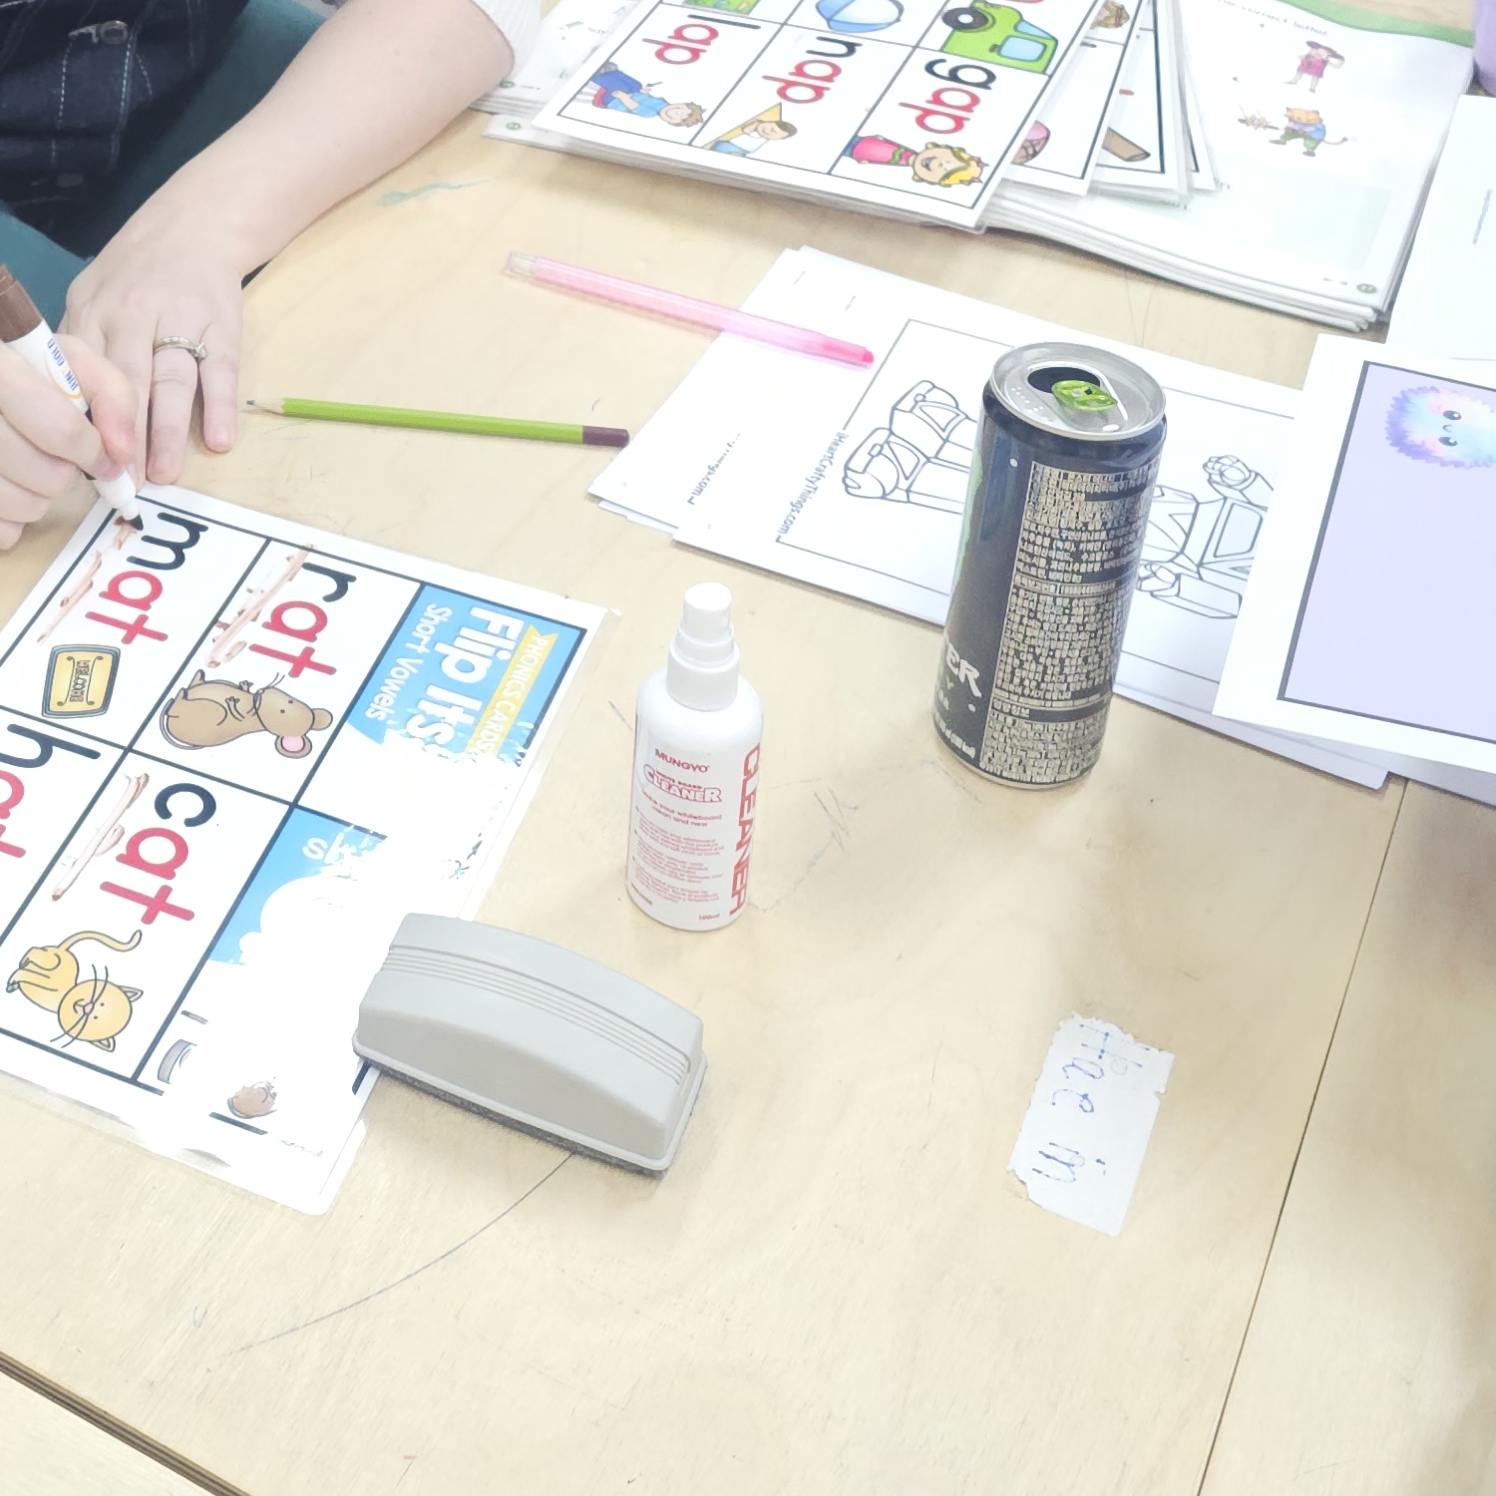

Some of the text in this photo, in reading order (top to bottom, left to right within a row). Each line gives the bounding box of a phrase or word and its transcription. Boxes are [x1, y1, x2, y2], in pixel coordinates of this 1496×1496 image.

[641, 13, 762, 66] lap
[761, 34, 864, 105] nap
[898, 57, 997, 135] gap
[84, 511, 211, 645] mat
[247, 560, 358, 679] rat
[364, 603, 453, 721] Short Vowels
[406, 606, 525, 746] Flip Its
[473, 634, 550, 755] PHONICS CARDS
[654, 748, 710, 773] MUNGYO
[99, 781, 218, 925] cat
